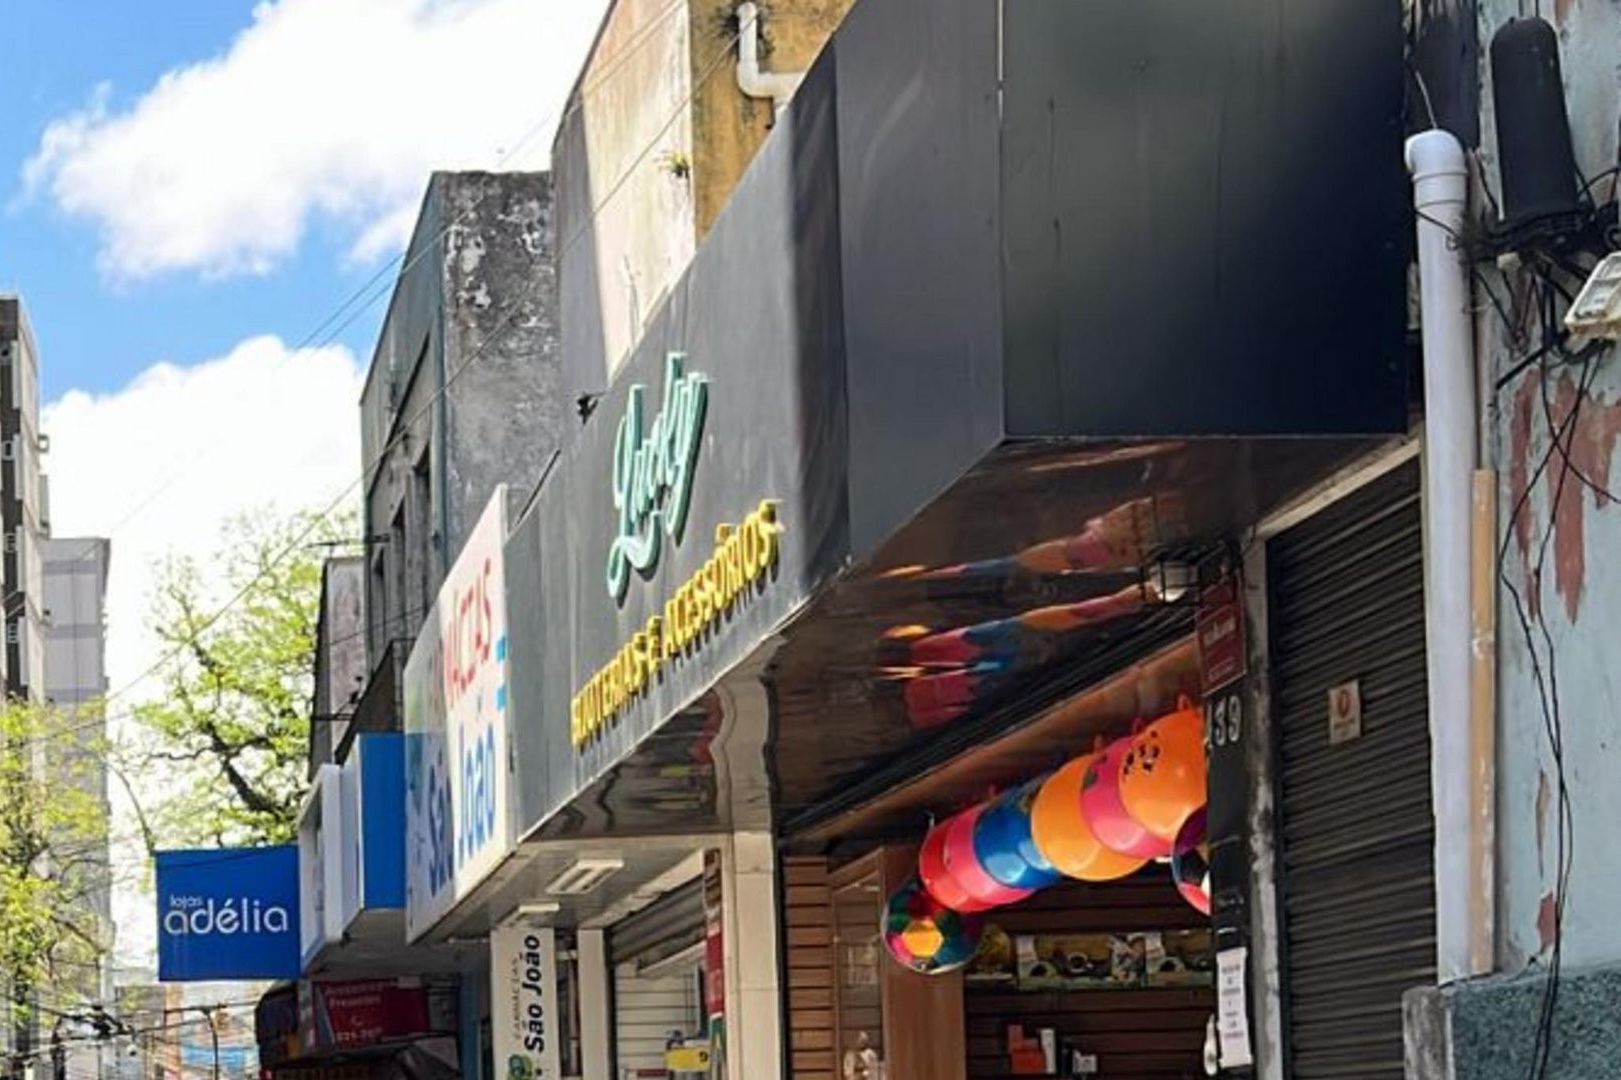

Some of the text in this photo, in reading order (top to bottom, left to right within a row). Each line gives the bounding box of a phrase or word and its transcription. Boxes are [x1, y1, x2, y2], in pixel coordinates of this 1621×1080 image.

[607, 352, 709, 598] Lucky
[662, 499, 781, 661] ACESSÓRIOS
[164, 897, 288, 935] adélia
[519, 934, 544, 1053] São João
